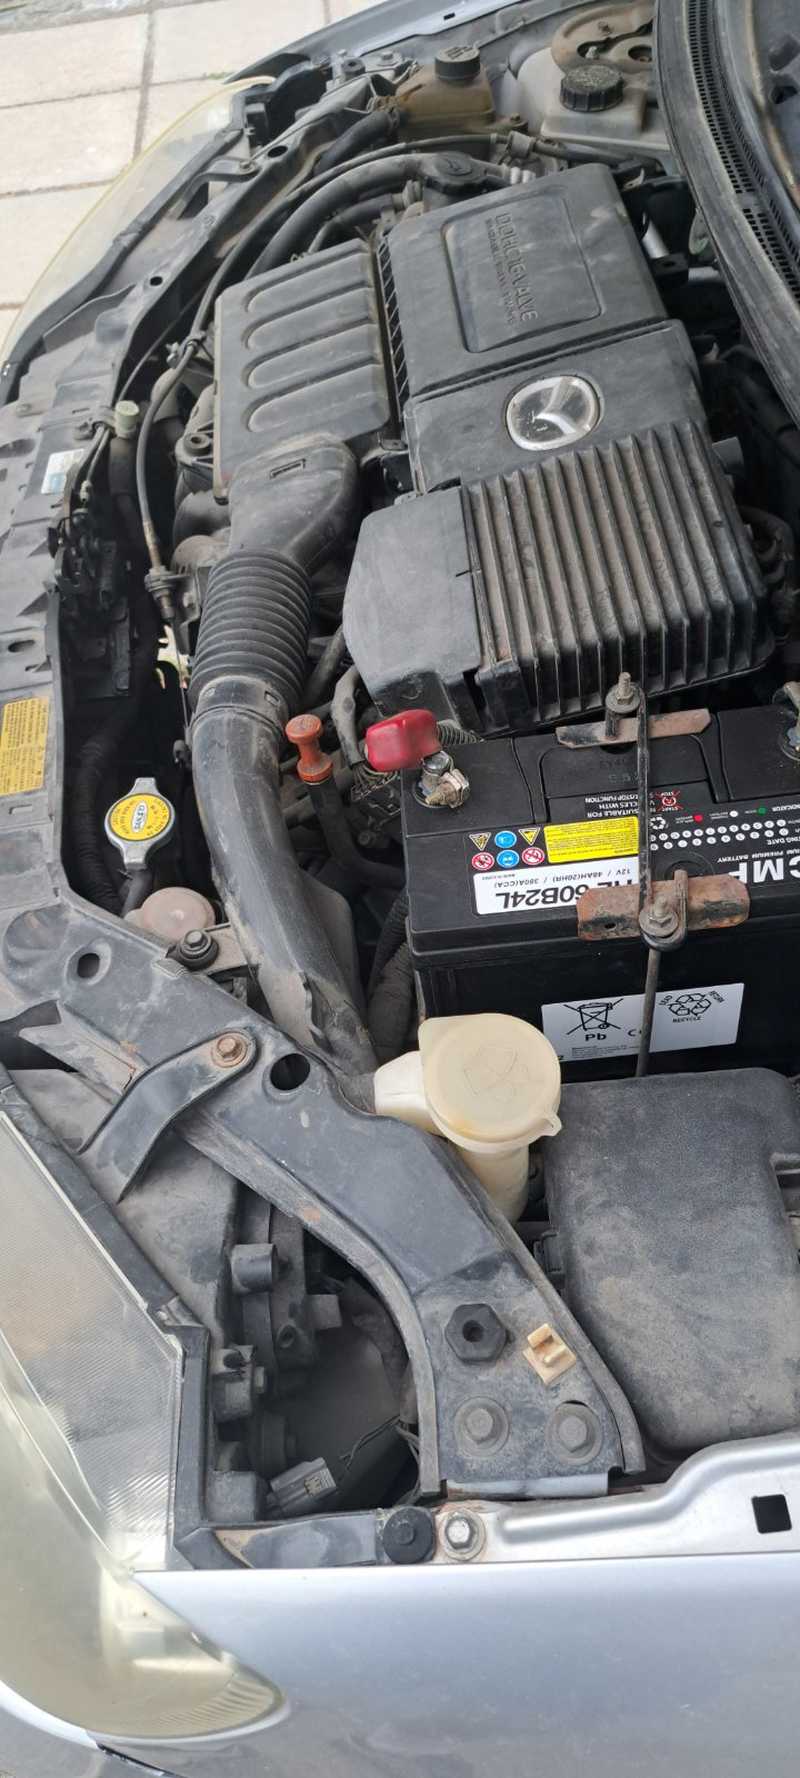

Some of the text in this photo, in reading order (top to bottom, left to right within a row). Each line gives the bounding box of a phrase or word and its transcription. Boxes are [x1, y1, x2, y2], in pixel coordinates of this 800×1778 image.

[585, 795, 617, 803] FUNCTION
[717, 854, 748, 863] BATTERY
[495, 883, 589, 909] 60B24L
[585, 1033, 607, 1042] Pb
